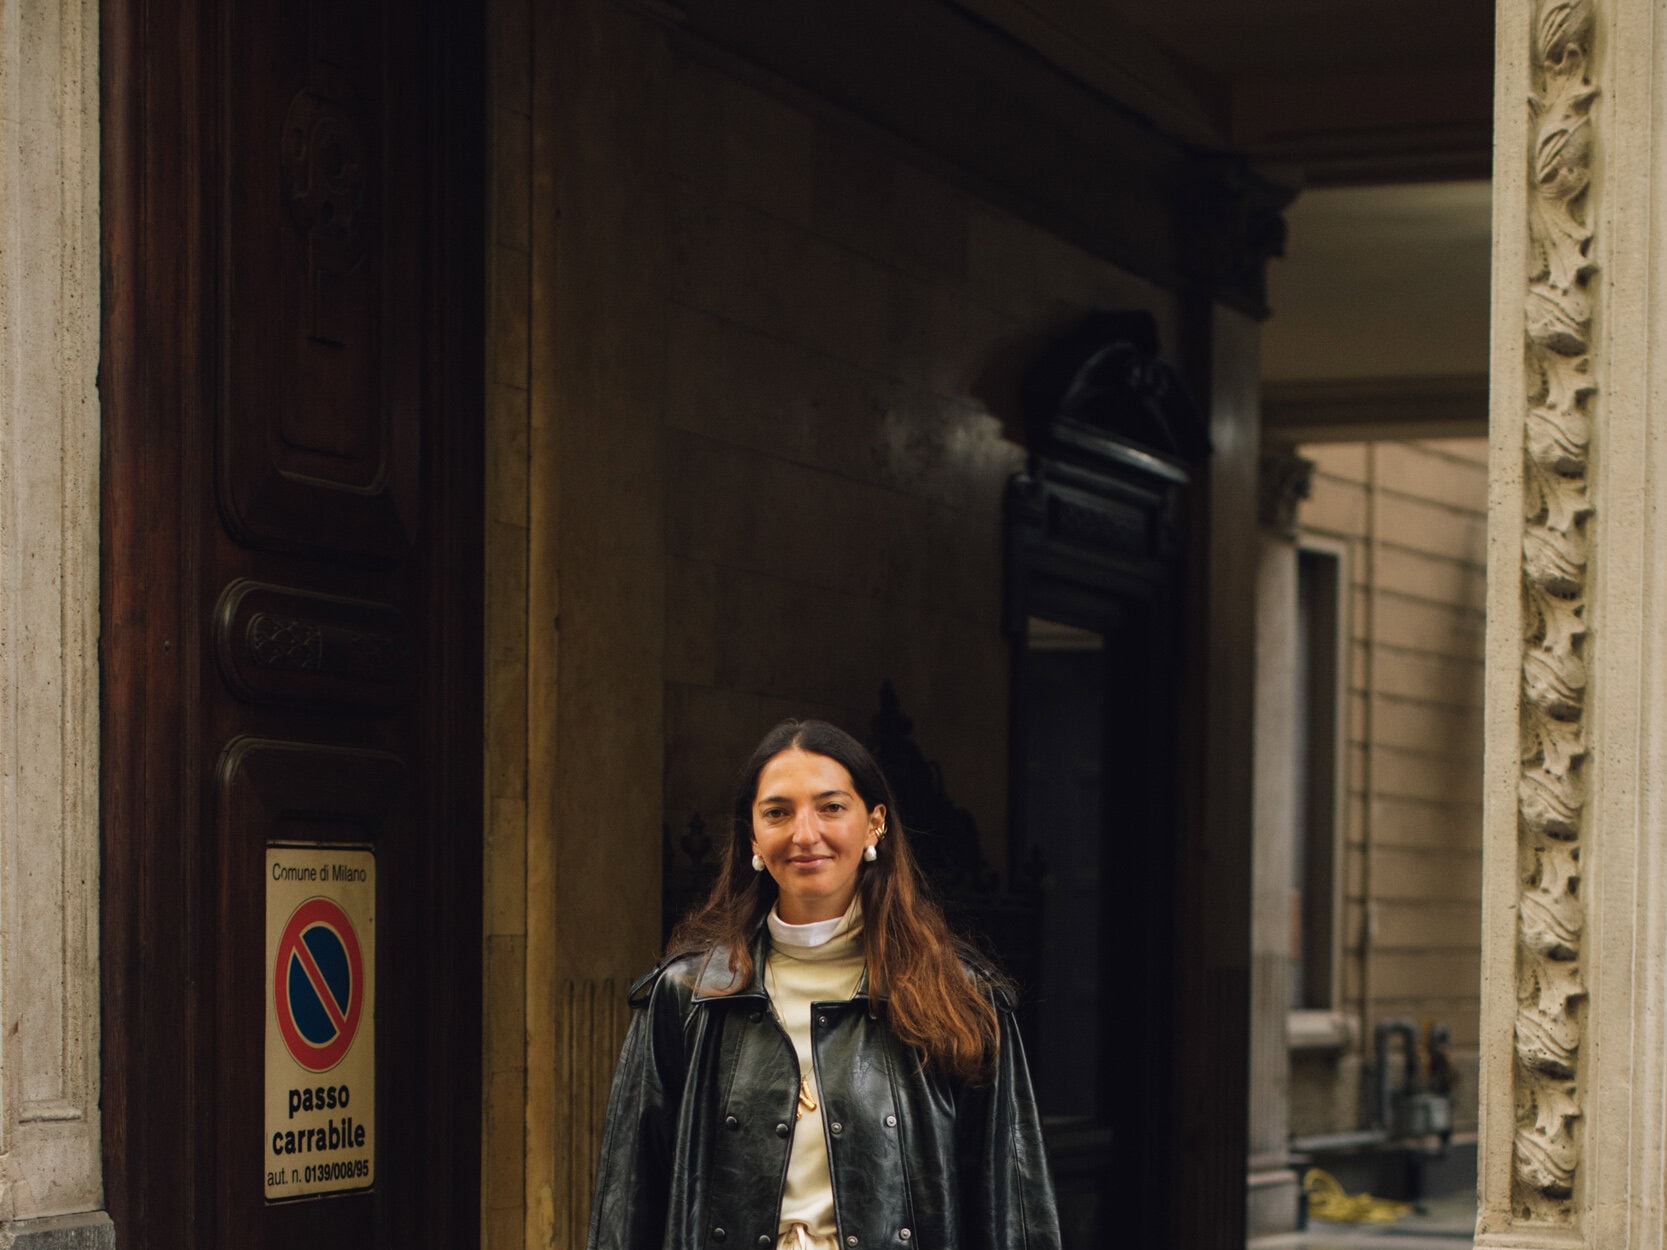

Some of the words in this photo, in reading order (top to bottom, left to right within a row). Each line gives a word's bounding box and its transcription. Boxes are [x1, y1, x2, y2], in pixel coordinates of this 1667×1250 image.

[272, 862, 317, 881] Comune
[320, 864, 329, 881] di
[332, 864, 367, 882] Milano
[288, 1084, 350, 1119] passo
[272, 1117, 366, 1156] carrabile
[267, 1167, 288, 1187] aut.
[292, 1168, 302, 1184] n.
[304, 1160, 369, 1184] 0139/008/95
